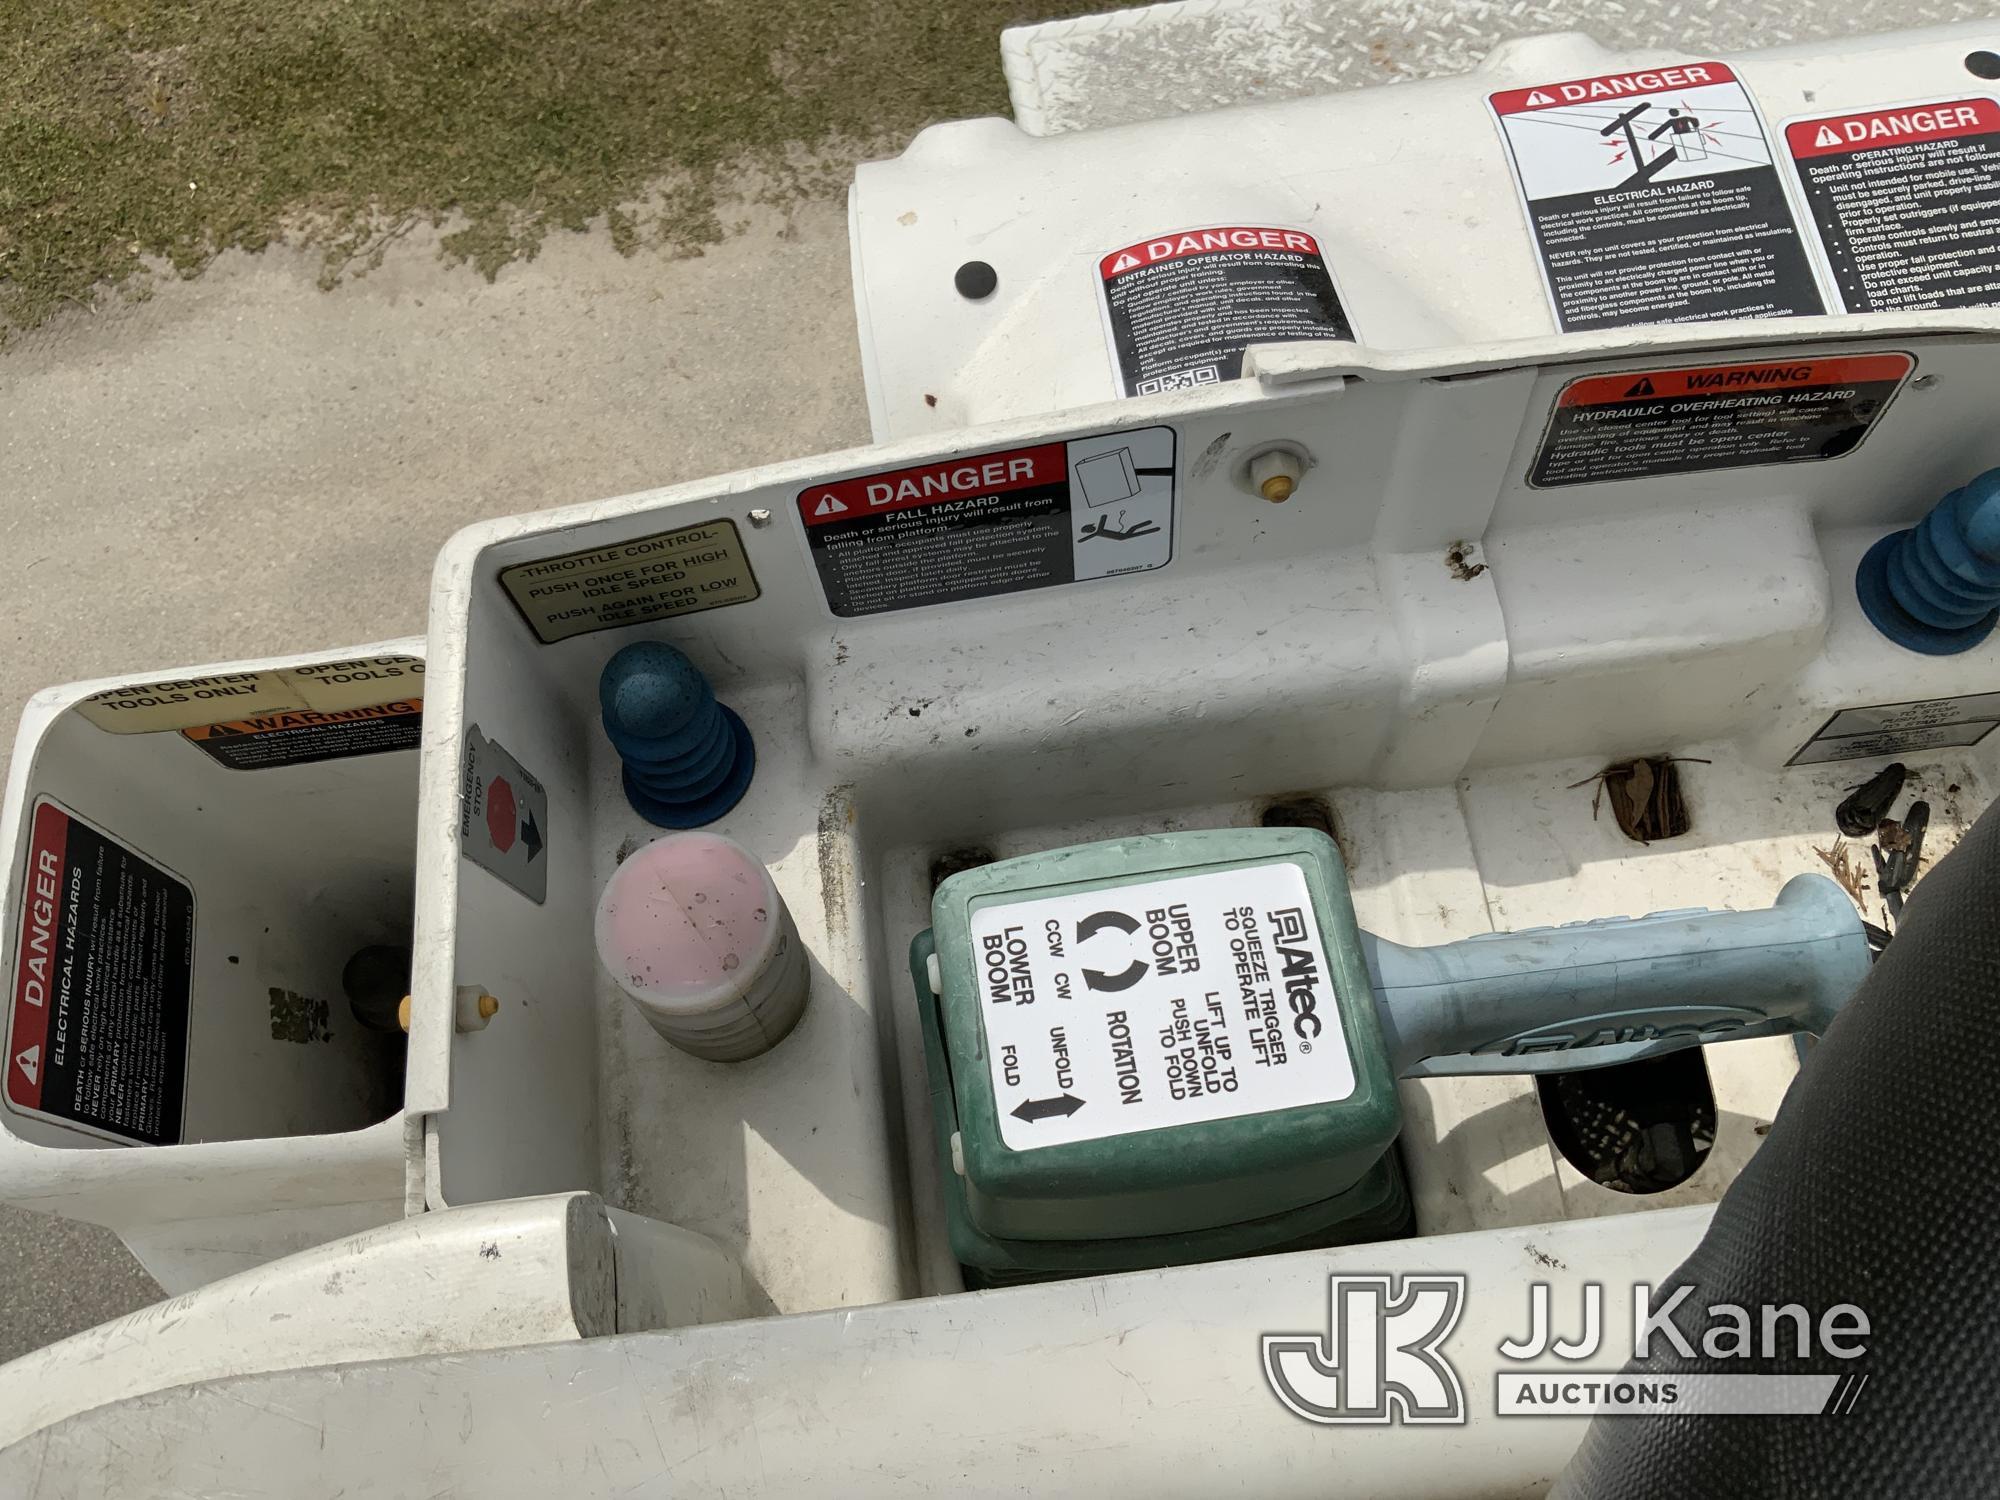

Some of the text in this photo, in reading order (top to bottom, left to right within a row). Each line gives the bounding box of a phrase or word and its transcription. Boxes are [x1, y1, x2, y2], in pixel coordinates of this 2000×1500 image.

[1561, 67, 1712, 102] DANGER
[1844, 107, 1980, 142] DANGER
[1809, 143, 1985, 176] Death or serious injury will result if
[1851, 139, 1959, 162] OPERATING HAZARD
[1593, 180, 1714, 206] ELECTRICAL HAZARD
[1829, 167, 1978, 193] Unit not intended for mobile use.
[1537, 212, 1560, 222] Death
[1570, 207, 1599, 218] serious
[1598, 204, 1622, 215] injury
[1621, 202, 1636, 210] will
[1635, 198, 1658, 208] result
[1658, 196, 1677, 205] from
[1677, 192, 1702, 202] failure
[1701, 191, 1711, 199] to
[1710, 187, 1735, 197] follow
[1734, 185, 1751, 194] safe
[1147, 230, 1312, 260] DANGER
[1845, 226, 1865, 236] firm
[1109, 281, 1135, 294] Death
[1145, 270, 1176, 285] serious
[1177, 266, 1201, 278] injury
[1201, 263, 1217, 272] will
[1217, 261, 1241, 269] result
[1242, 259, 1263, 267] from
[1263, 260, 1305, 270] operating
[1305, 262, 1320, 270] this
[1117, 253, 1302, 285] UNTRAINED OPERATOR HAZARD
[1861, 259, 1963, 282] protective equipment.
[1112, 274, 1227, 306] Do not operate unit unless:
[1867, 287, 1888, 298] load
[1688, 367, 1812, 389] WARNING
[1560, 406, 1830, 436] Use of closed center tool (or tool setting) will cause
[1573, 388, 1856, 422] HYDRAULIC OVERHEATING HAZARD
[1550, 429, 1792, 461] Hydraulic tools must be open center
[867, 458, 1035, 506] DANGER
[823, 497, 1052, 542] Death or serious injury will result from
[885, 496, 999, 523] FALL HAZARD
[826, 537, 863, 552] falling
[866, 532, 894, 544] from
[529, 548, 728, 599] PUSH ONCE FOR HIGH
[582, 569, 686, 598] IDLE SPEED
[546, 605, 596, 623] PUSH
[600, 593, 655, 613] AGAIN
[658, 585, 698, 601] FOR
[699, 577, 738, 593] LOW
[598, 607, 636, 622] IDLE
[639, 595, 698, 614] SPEED
[296, 660, 368, 675] OPEN
[315, 668, 404, 685] TOOLS
[102, 685, 258, 710] TOOLS ONLY
[253, 719, 385, 740] ELECTRICAL HAZARDS
[463, 743, 476, 837] EMERGENCY
[474, 776, 482, 816] STOP
[25, 846, 58, 1007] DANGER
[1045, 919, 1065, 957] CCW
[1146, 909, 1177, 976] BOOM
[1168, 904, 1200, 974] UPPER
[54, 866, 82, 1066] ELECTRICAL HAZARDS
[983, 934, 1012, 1003] BOOM
[1004, 926, 1035, 1005] LOWER
[1054, 973, 1072, 1000] CW
[1223, 908, 1271, 1067] TO OPERATE LIFT
[1239, 907, 1287, 1065] SQUEEZE TRIGGER
[1050, 1026, 1073, 1089] UNFOLD
[1106, 1011, 1142, 1105] ROTATION
[1171, 998, 1203, 1098] PUSH DOWN
[1194, 1019, 1220, 1094] UNFOLD
[1205, 991, 1238, 1092] LIFT UP TO
[1001, 1045, 1020, 1086] FOLD
[1159, 1025, 1186, 1100] TO FOLD
